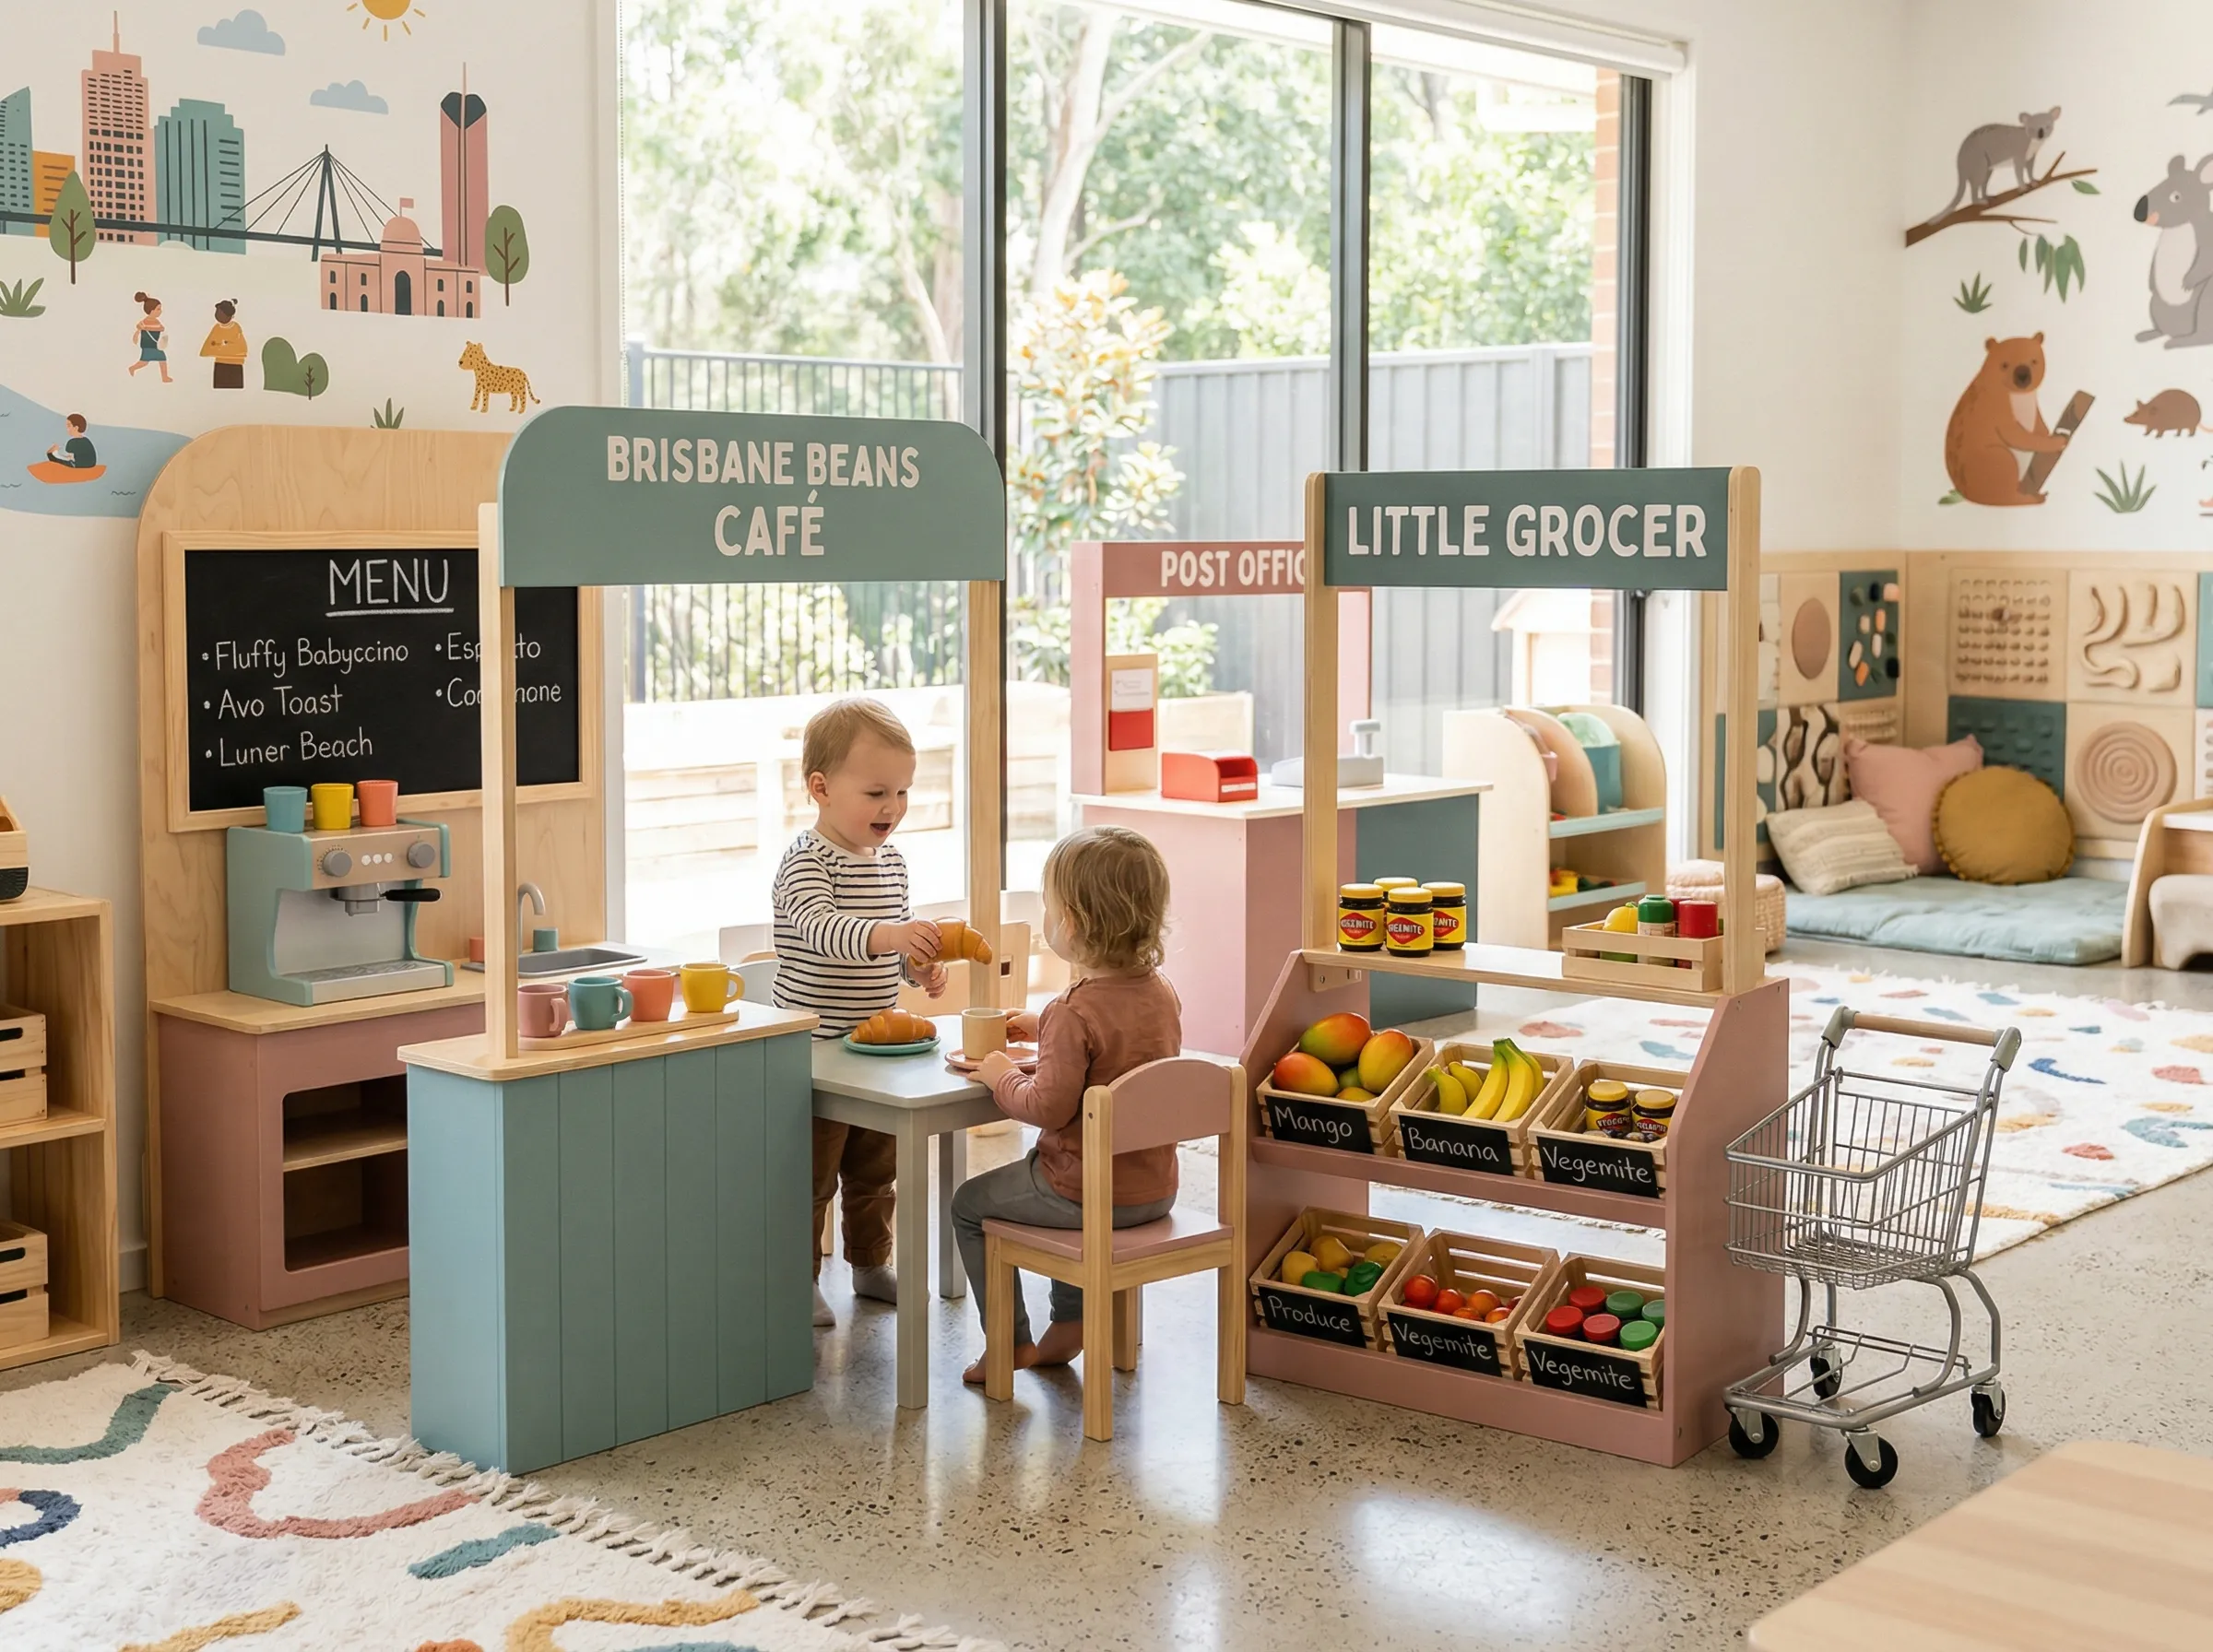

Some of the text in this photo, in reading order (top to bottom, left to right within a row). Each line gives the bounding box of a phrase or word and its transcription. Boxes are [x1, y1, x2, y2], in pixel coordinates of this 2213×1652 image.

[607, 435, 921, 490] BRISBANE BEANS
[714, 488, 825, 557] CAFÉ
[1348, 503, 1708, 558] LITTLE GROCER
[329, 558, 450, 607] MENU
[1161, 549, 1305, 588] POST OFFIC
[216, 636, 410, 678] Fluffy Babyccino
[218, 683, 344, 720] Avo Toast
[219, 726, 373, 768] Luner Beach
[1275, 1105, 1353, 1144] Mango
[1409, 1127, 1499, 1162] Banana
[1542, 1145, 1651, 1184] Vegemite
[1268, 1296, 1354, 1334] Produce
[1393, 1322, 1492, 1361] Vegemite
[1531, 1350, 1635, 1391] Vegemite
